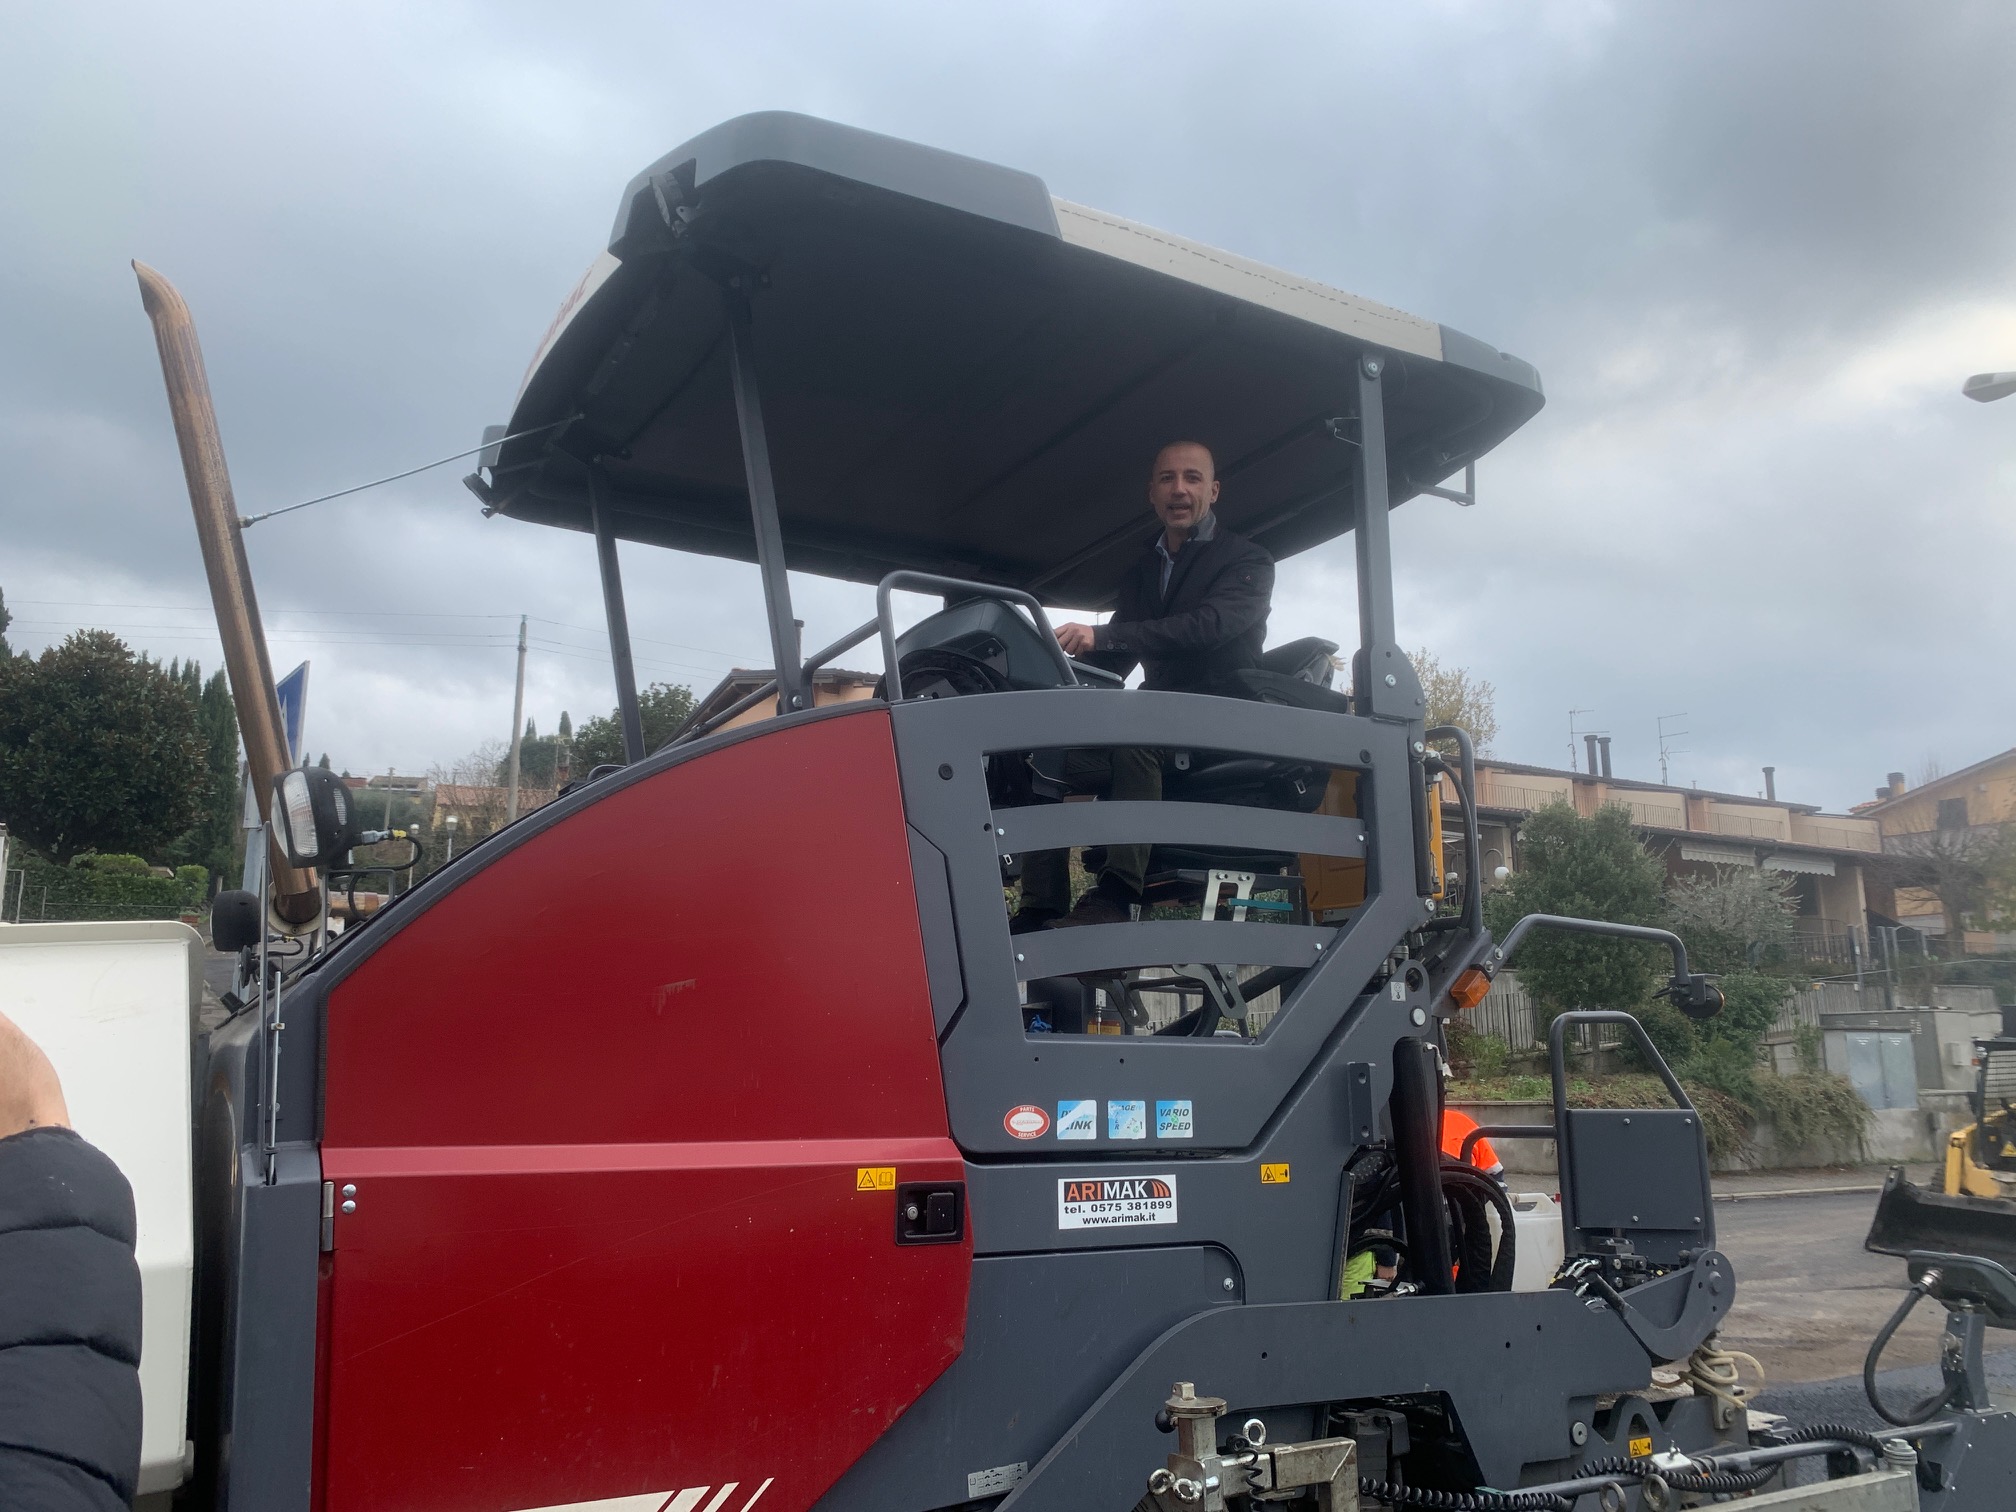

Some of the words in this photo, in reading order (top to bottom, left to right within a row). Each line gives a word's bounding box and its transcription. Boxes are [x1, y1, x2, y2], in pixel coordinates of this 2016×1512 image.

[1160, 1108, 1189, 1117] VARIO
[1065, 1120, 1092, 1130] INK
[1159, 1122, 1191, 1131] SPEED
[1066, 1180, 1148, 1202] ARIMAK
[1064, 1205, 1086, 1214] tel.
[1091, 1202, 1122, 1213] 0575
[1127, 1200, 1172, 1211] 381899
[1082, 1212, 1156, 1225] www.arimak.it
